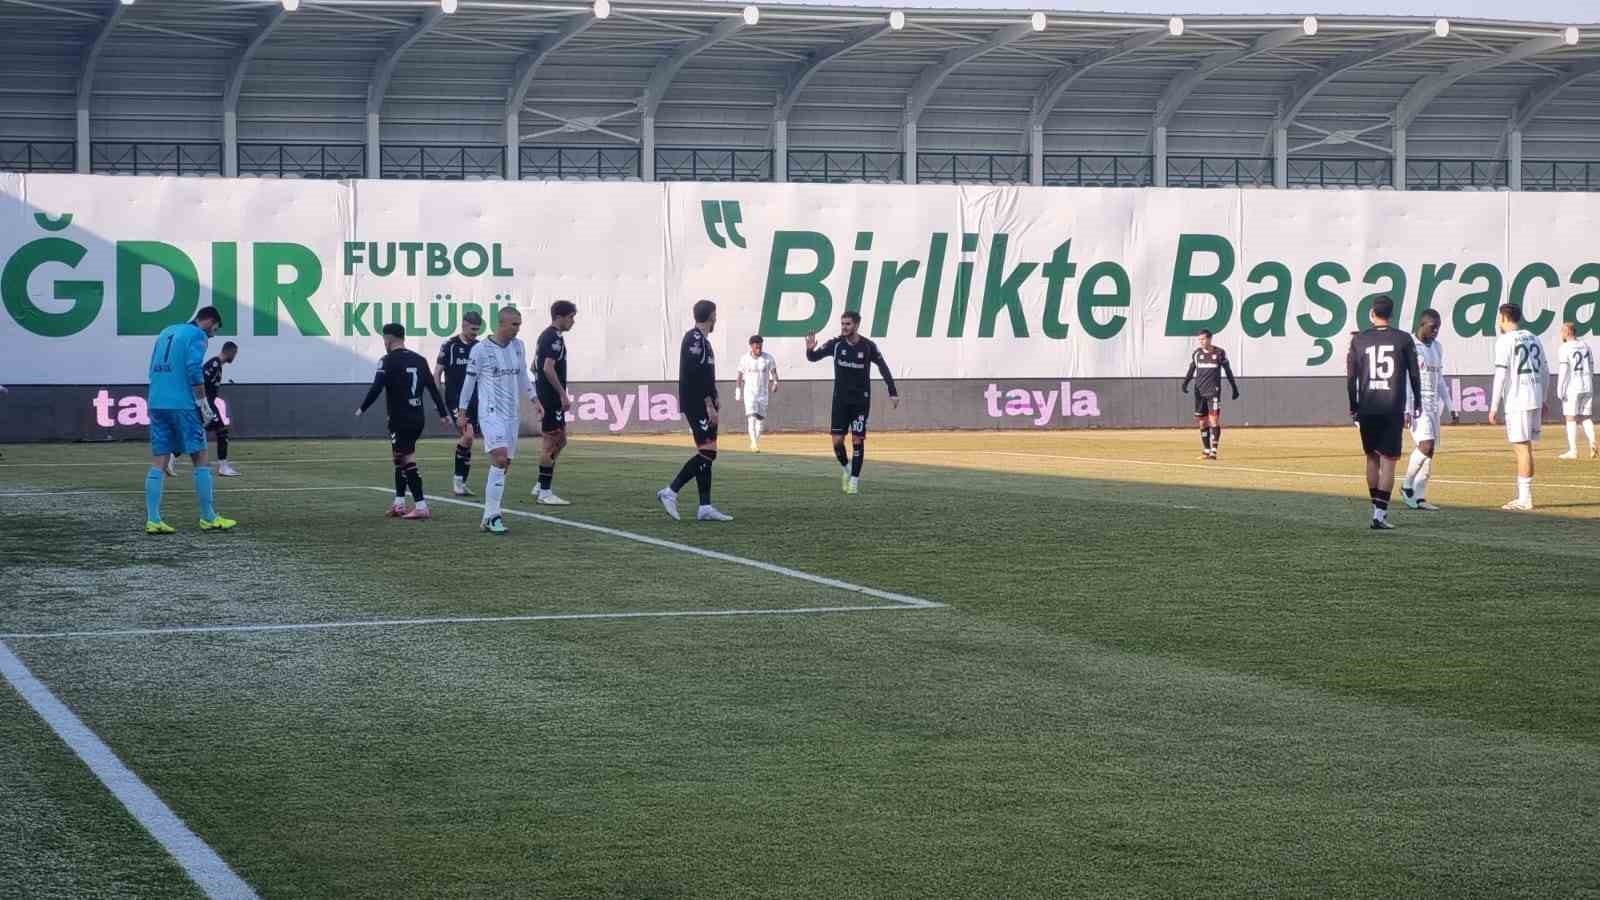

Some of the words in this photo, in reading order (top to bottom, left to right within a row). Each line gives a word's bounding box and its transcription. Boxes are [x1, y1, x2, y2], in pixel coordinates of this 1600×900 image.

[344, 241, 514, 277] FUTBOL
[164, 334, 175, 363] 1
[1365, 345, 1394, 380] 15
[1515, 343, 1541, 375] 23
[406, 367, 418, 397] 7
[984, 383, 1101, 426] tayla
